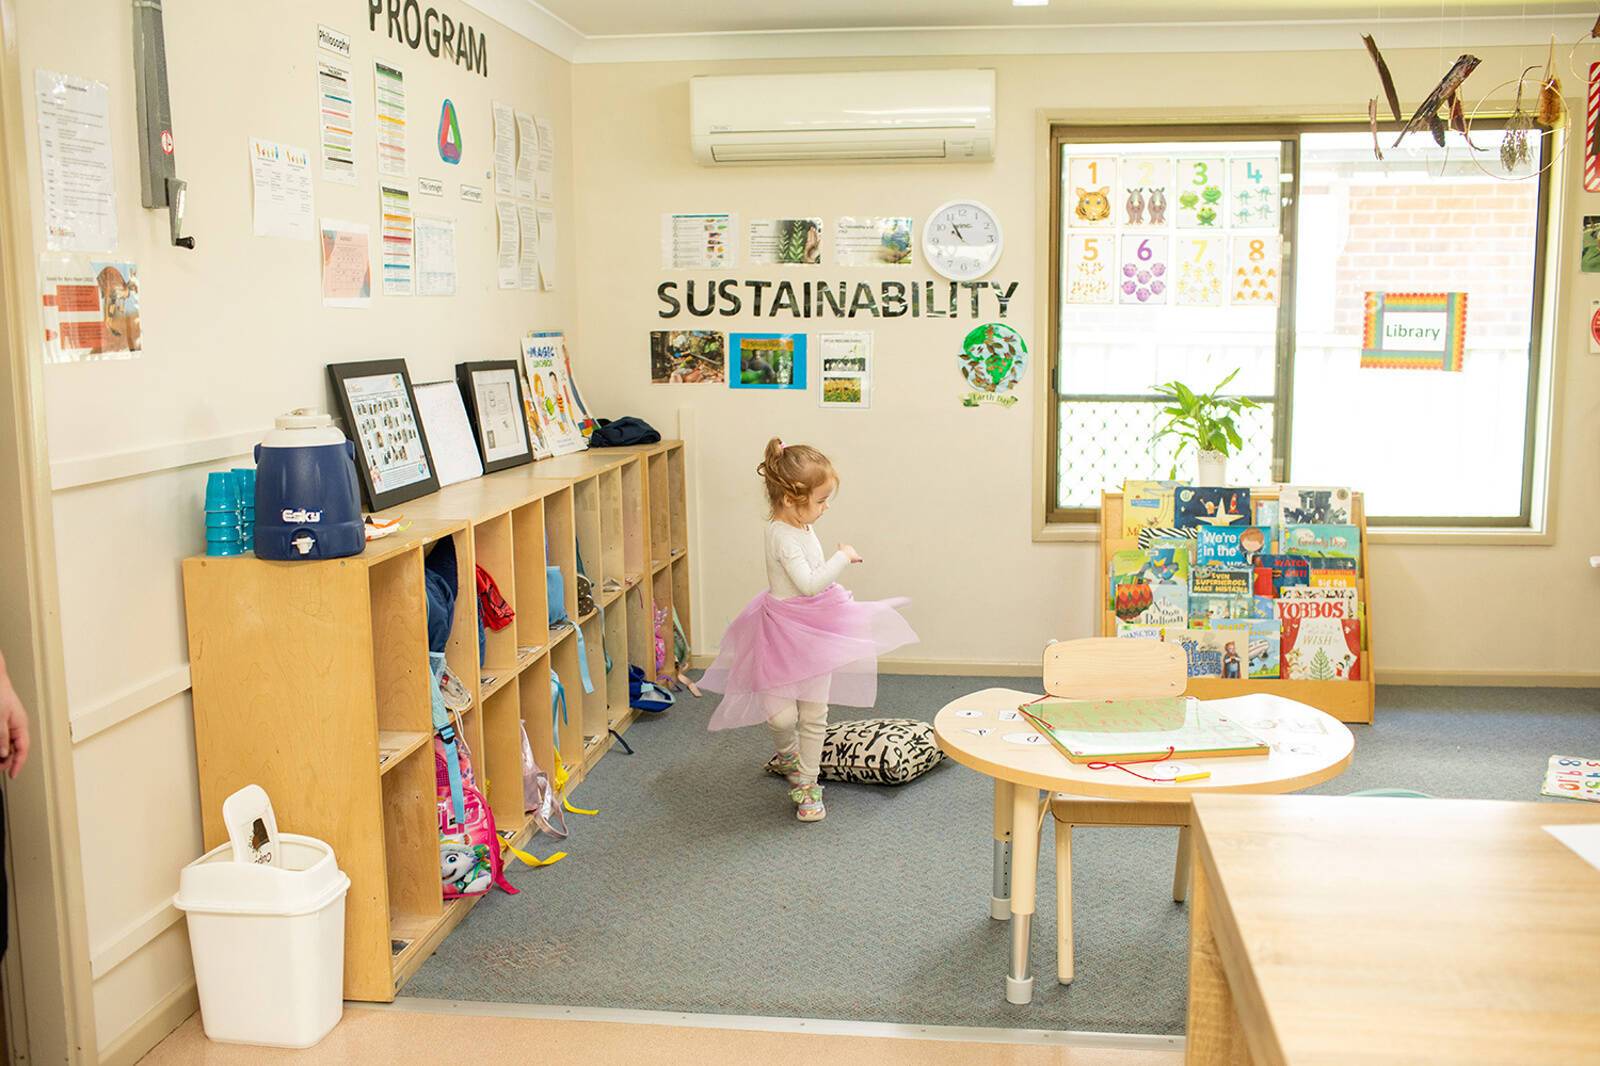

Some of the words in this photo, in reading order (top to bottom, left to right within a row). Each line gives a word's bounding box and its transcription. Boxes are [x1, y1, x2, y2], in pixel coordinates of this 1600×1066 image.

[319, 29, 350, 54] Philosophy
[368, 0, 487, 77] PROGRAM
[1087, 161, 1097, 184] 1
[1137, 161, 1153, 183] 2
[1192, 162, 1208, 185] 3
[1247, 162, 1263, 184] 4
[1082, 238, 1099, 261] 5
[1137, 239, 1153, 261] 6
[1192, 240, 1208, 262] 7
[1248, 239, 1265, 261] 8
[657, 279, 1020, 319] SUSTAINABILITY
[1386, 324, 1440, 341] Library
[1203, 532, 1237, 544] We're
[1203, 545, 1215, 557] in
[1217, 544, 1237, 557] the
[1277, 602, 1345, 619] YOBBOS
